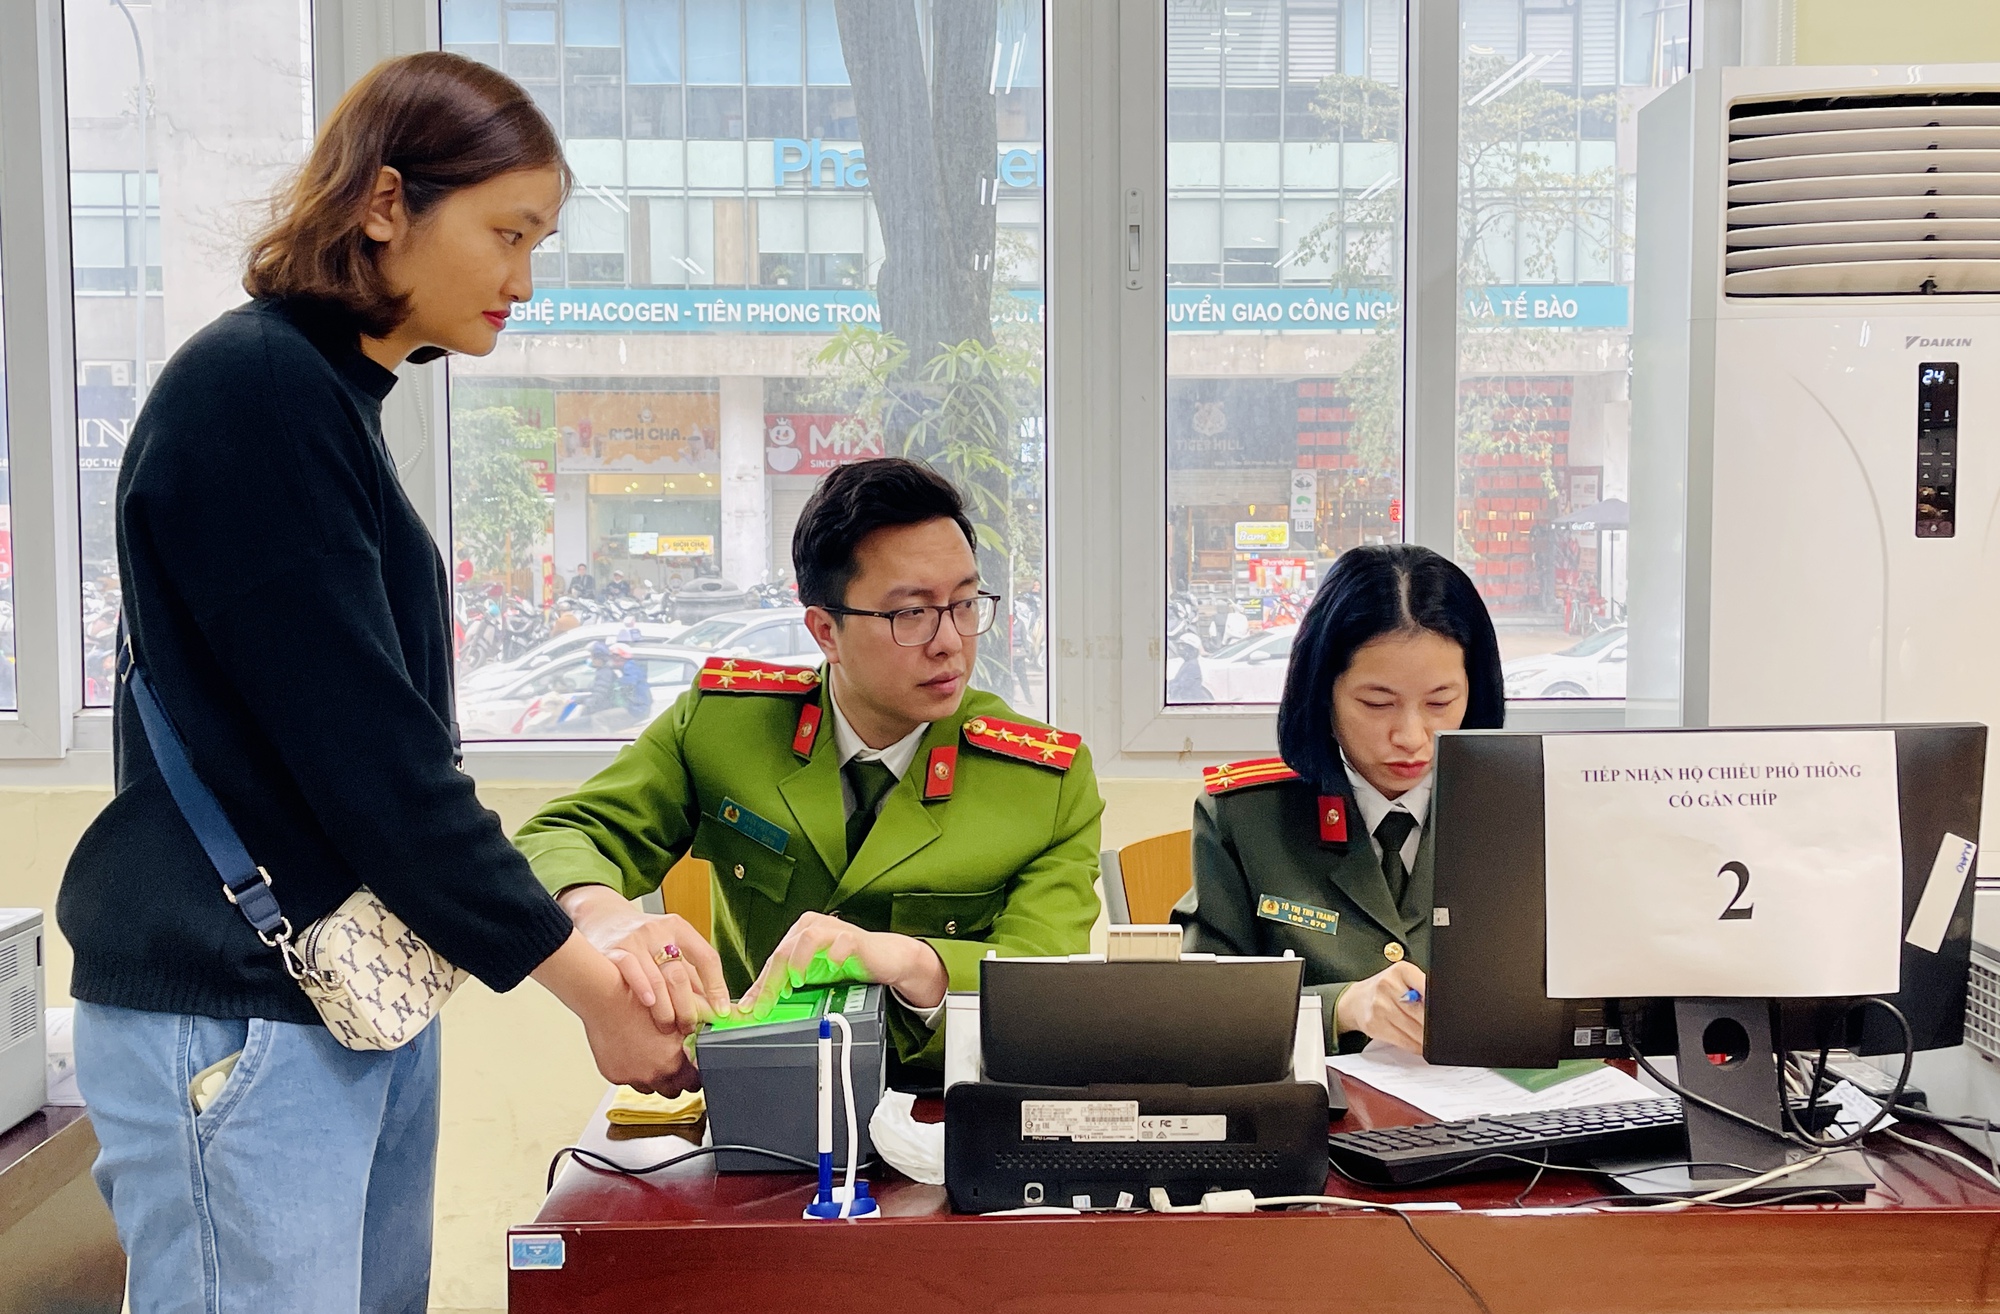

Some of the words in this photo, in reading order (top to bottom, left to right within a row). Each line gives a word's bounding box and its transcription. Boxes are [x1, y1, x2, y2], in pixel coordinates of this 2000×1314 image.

[559, 302, 679, 322] PHACOGEN
[694, 298, 742, 323] TIÊN
[747, 303, 820, 323] PHONG
[1232, 302, 1283, 322] GIAO
[1288, 298, 1350, 322] CÔNG
[1469, 294, 1495, 319] VÀ
[1501, 291, 1528, 319] TẾ
[1534, 294, 1578, 319] BÀO
[1919, 337, 1972, 347] DAIKIN
[1922, 368, 1945, 385] 24
[608, 428, 644, 440] RICH
[1176, 438, 1211, 450] TIGER
[1213, 438, 1244, 451] HILL
[810, 460, 836, 468] SINCE
[1580, 765, 1620, 782] TIẾP
[1625, 766, 1673, 784] NHẬN
[1679, 765, 1703, 783] HỘ
[1708, 763, 1761, 780] CHIẾU
[1803, 761, 1861, 778] THÔNG
[1669, 790, 1693, 808] CÓ
[1698, 790, 1733, 808] GẮN
[1738, 789, 1777, 807] CHÍP
[1717, 860, 1754, 920] 2
